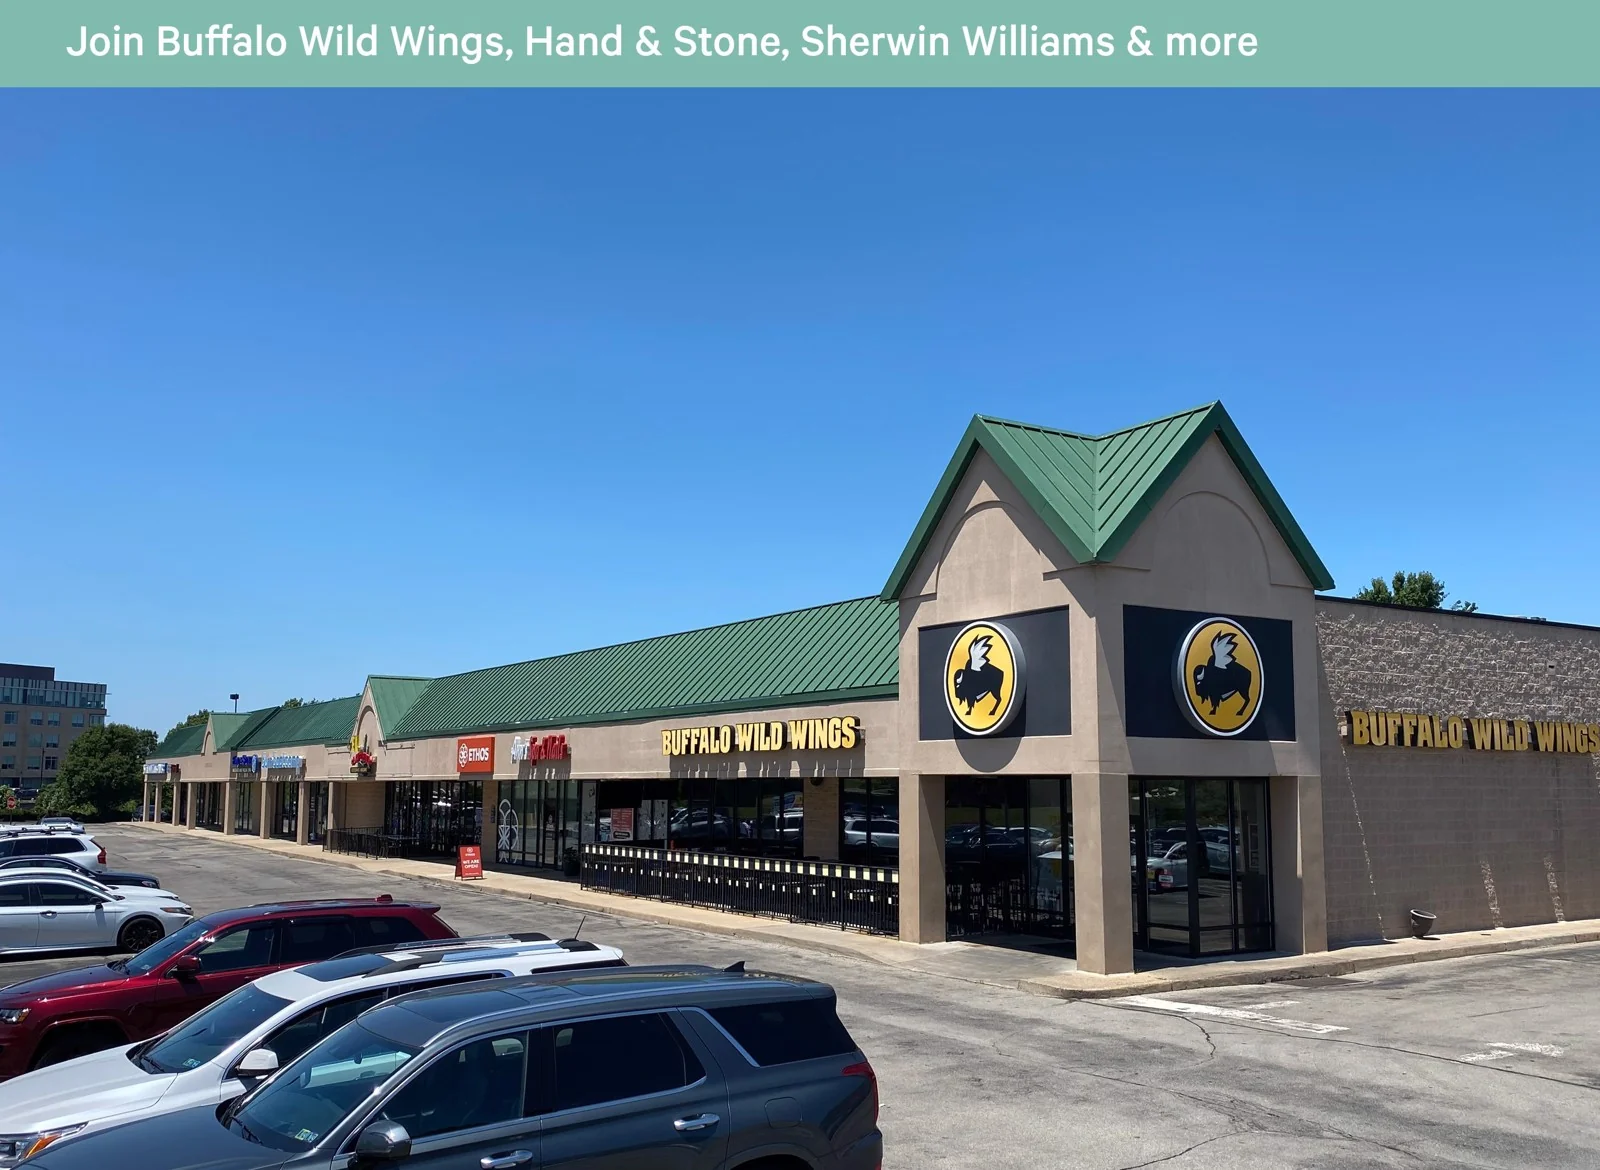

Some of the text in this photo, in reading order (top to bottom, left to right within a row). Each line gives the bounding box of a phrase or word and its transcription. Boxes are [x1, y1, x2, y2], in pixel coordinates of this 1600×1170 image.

[661, 716, 857, 756] BUFFALO WILD WINGS
[1351, 710, 1600, 754] BUFFALO WILD WINGS
[468, 747, 489, 762] ETHOS
